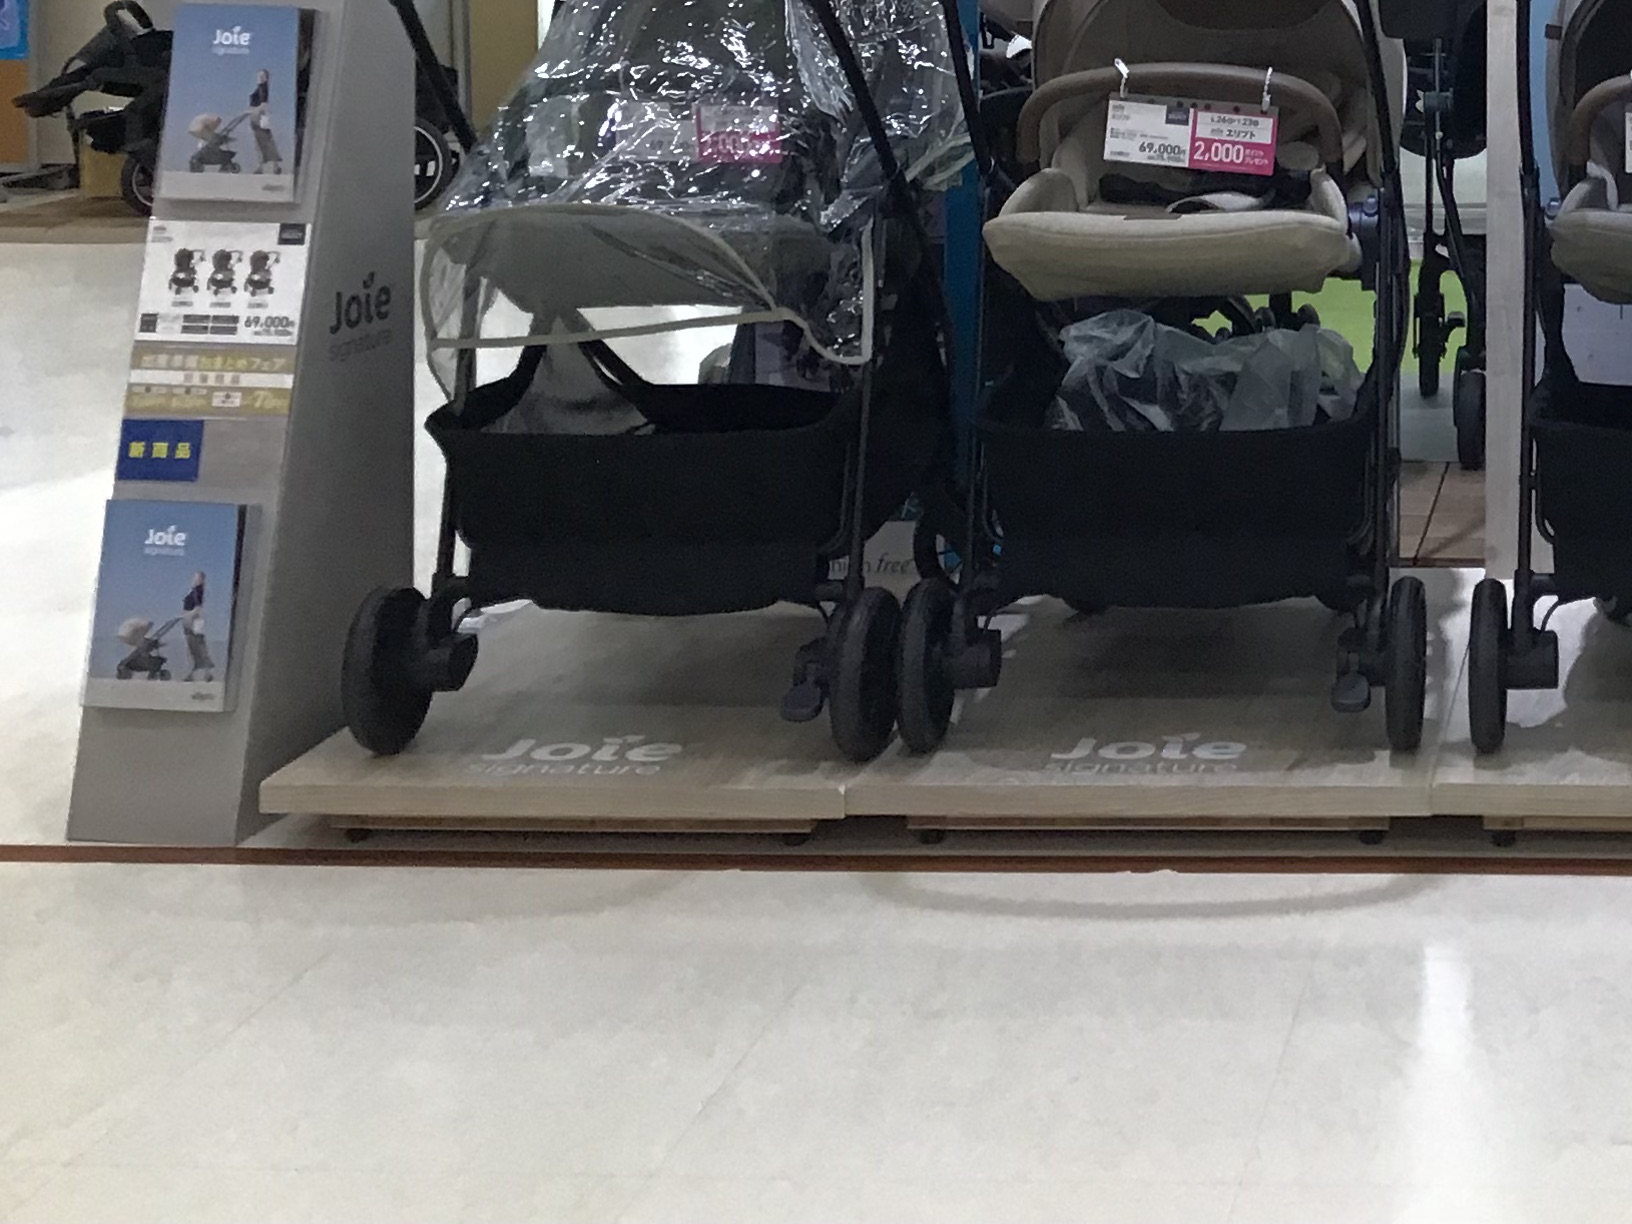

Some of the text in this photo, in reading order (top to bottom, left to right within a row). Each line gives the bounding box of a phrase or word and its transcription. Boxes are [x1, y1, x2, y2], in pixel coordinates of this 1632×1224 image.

[211, 25, 252, 47] Joie
[1194, 141, 1244, 165] 2,000
[330, 271, 391, 335] Joie
[144, 526, 187, 547] Joie
[482, 734, 683, 762] Joie
[1051, 732, 1247, 760] Joie
